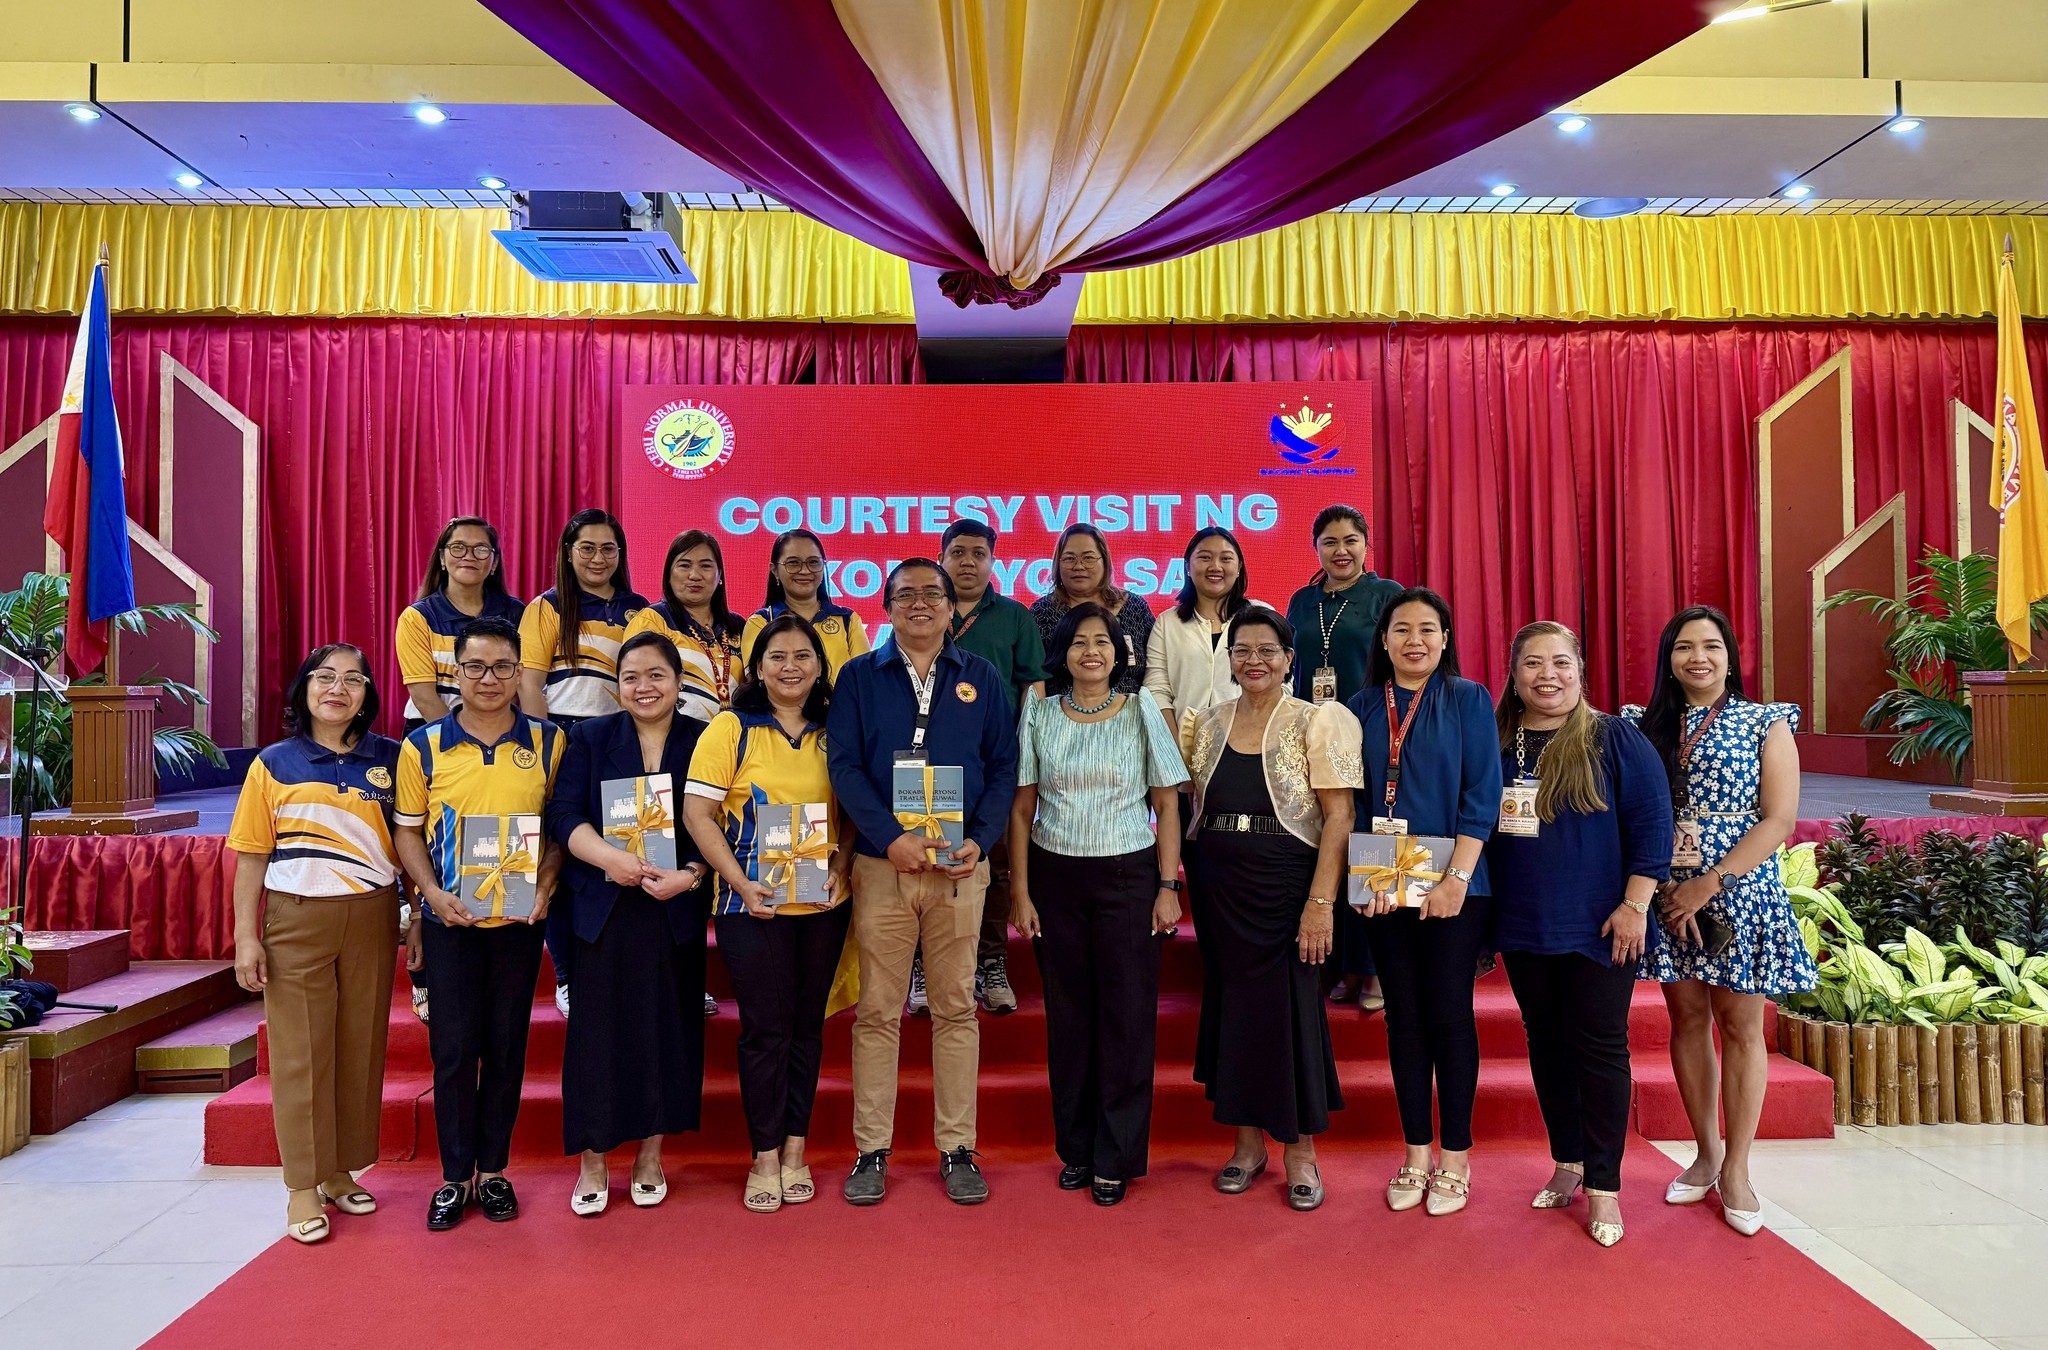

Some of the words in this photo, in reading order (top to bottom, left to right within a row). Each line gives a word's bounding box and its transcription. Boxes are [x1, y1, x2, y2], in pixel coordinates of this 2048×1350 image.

[644, 399, 695, 433] NORMAL
[698, 401, 735, 466] UNIVERSITY
[643, 437, 664, 468] CEBU
[719, 495, 1026, 535] COURTESY
[1035, 494, 1182, 533] VISIT
[1195, 493, 1279, 532] NG
[1123, 557, 1185, 595] SA
